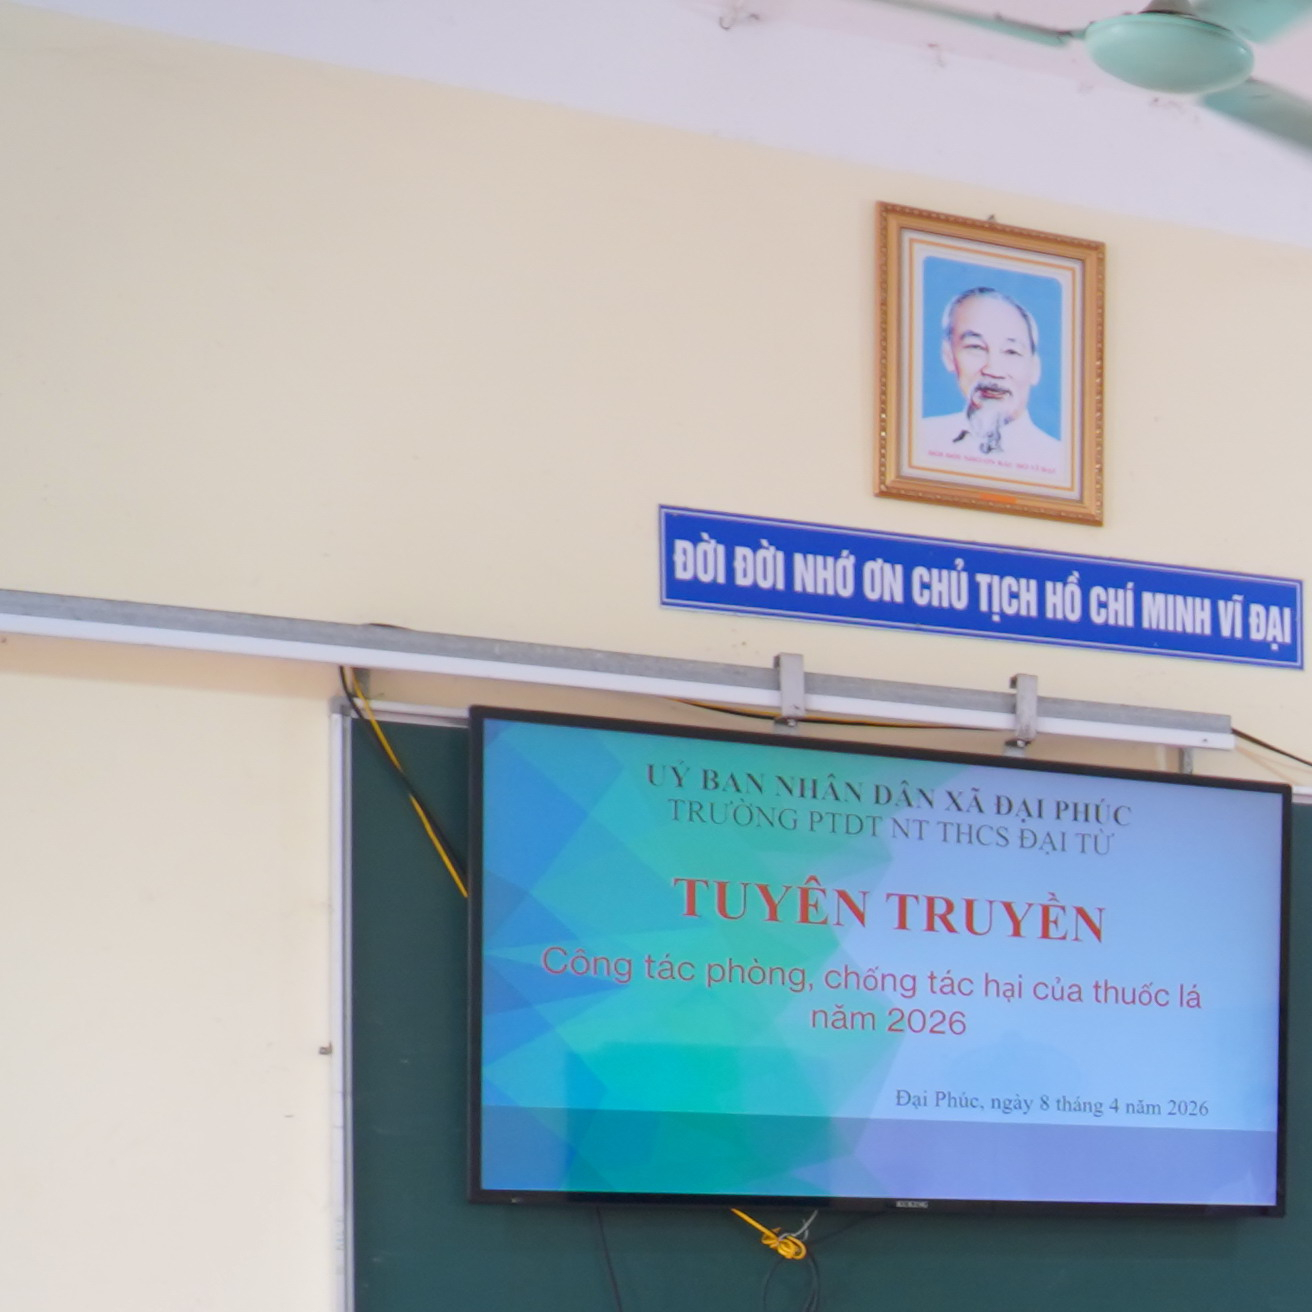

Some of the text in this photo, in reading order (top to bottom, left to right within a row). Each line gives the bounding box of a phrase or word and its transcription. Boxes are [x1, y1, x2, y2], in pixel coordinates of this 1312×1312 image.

[673, 532, 1292, 650] ĐỜI ĐỜI NHỚ ƠN CHỦ TỊCH HỒ CHÍ MINH VĨ ĐẠI
[702, 768, 765, 794] BAN
[775, 773, 863, 801] NHÂN
[874, 779, 934, 808] DÂN
[945, 787, 985, 814] XÃ
[995, 794, 1045, 824] ĐẠI
[1054, 798, 1133, 826] PHÚC
[668, 798, 1116, 856] TRƯỜNG PTDT NT THCS ĐẠI TỪ
[673, 875, 1106, 943] TUYÊN TRUYỀN
[541, 946, 1202, 1009] Công tác phòng, chống tác hại của thuốc lá
[811, 1004, 967, 1036] năm 2026
[896, 1089, 1209, 1118] Đại Phúc, ngày 8 tháng 4 năm 2026
